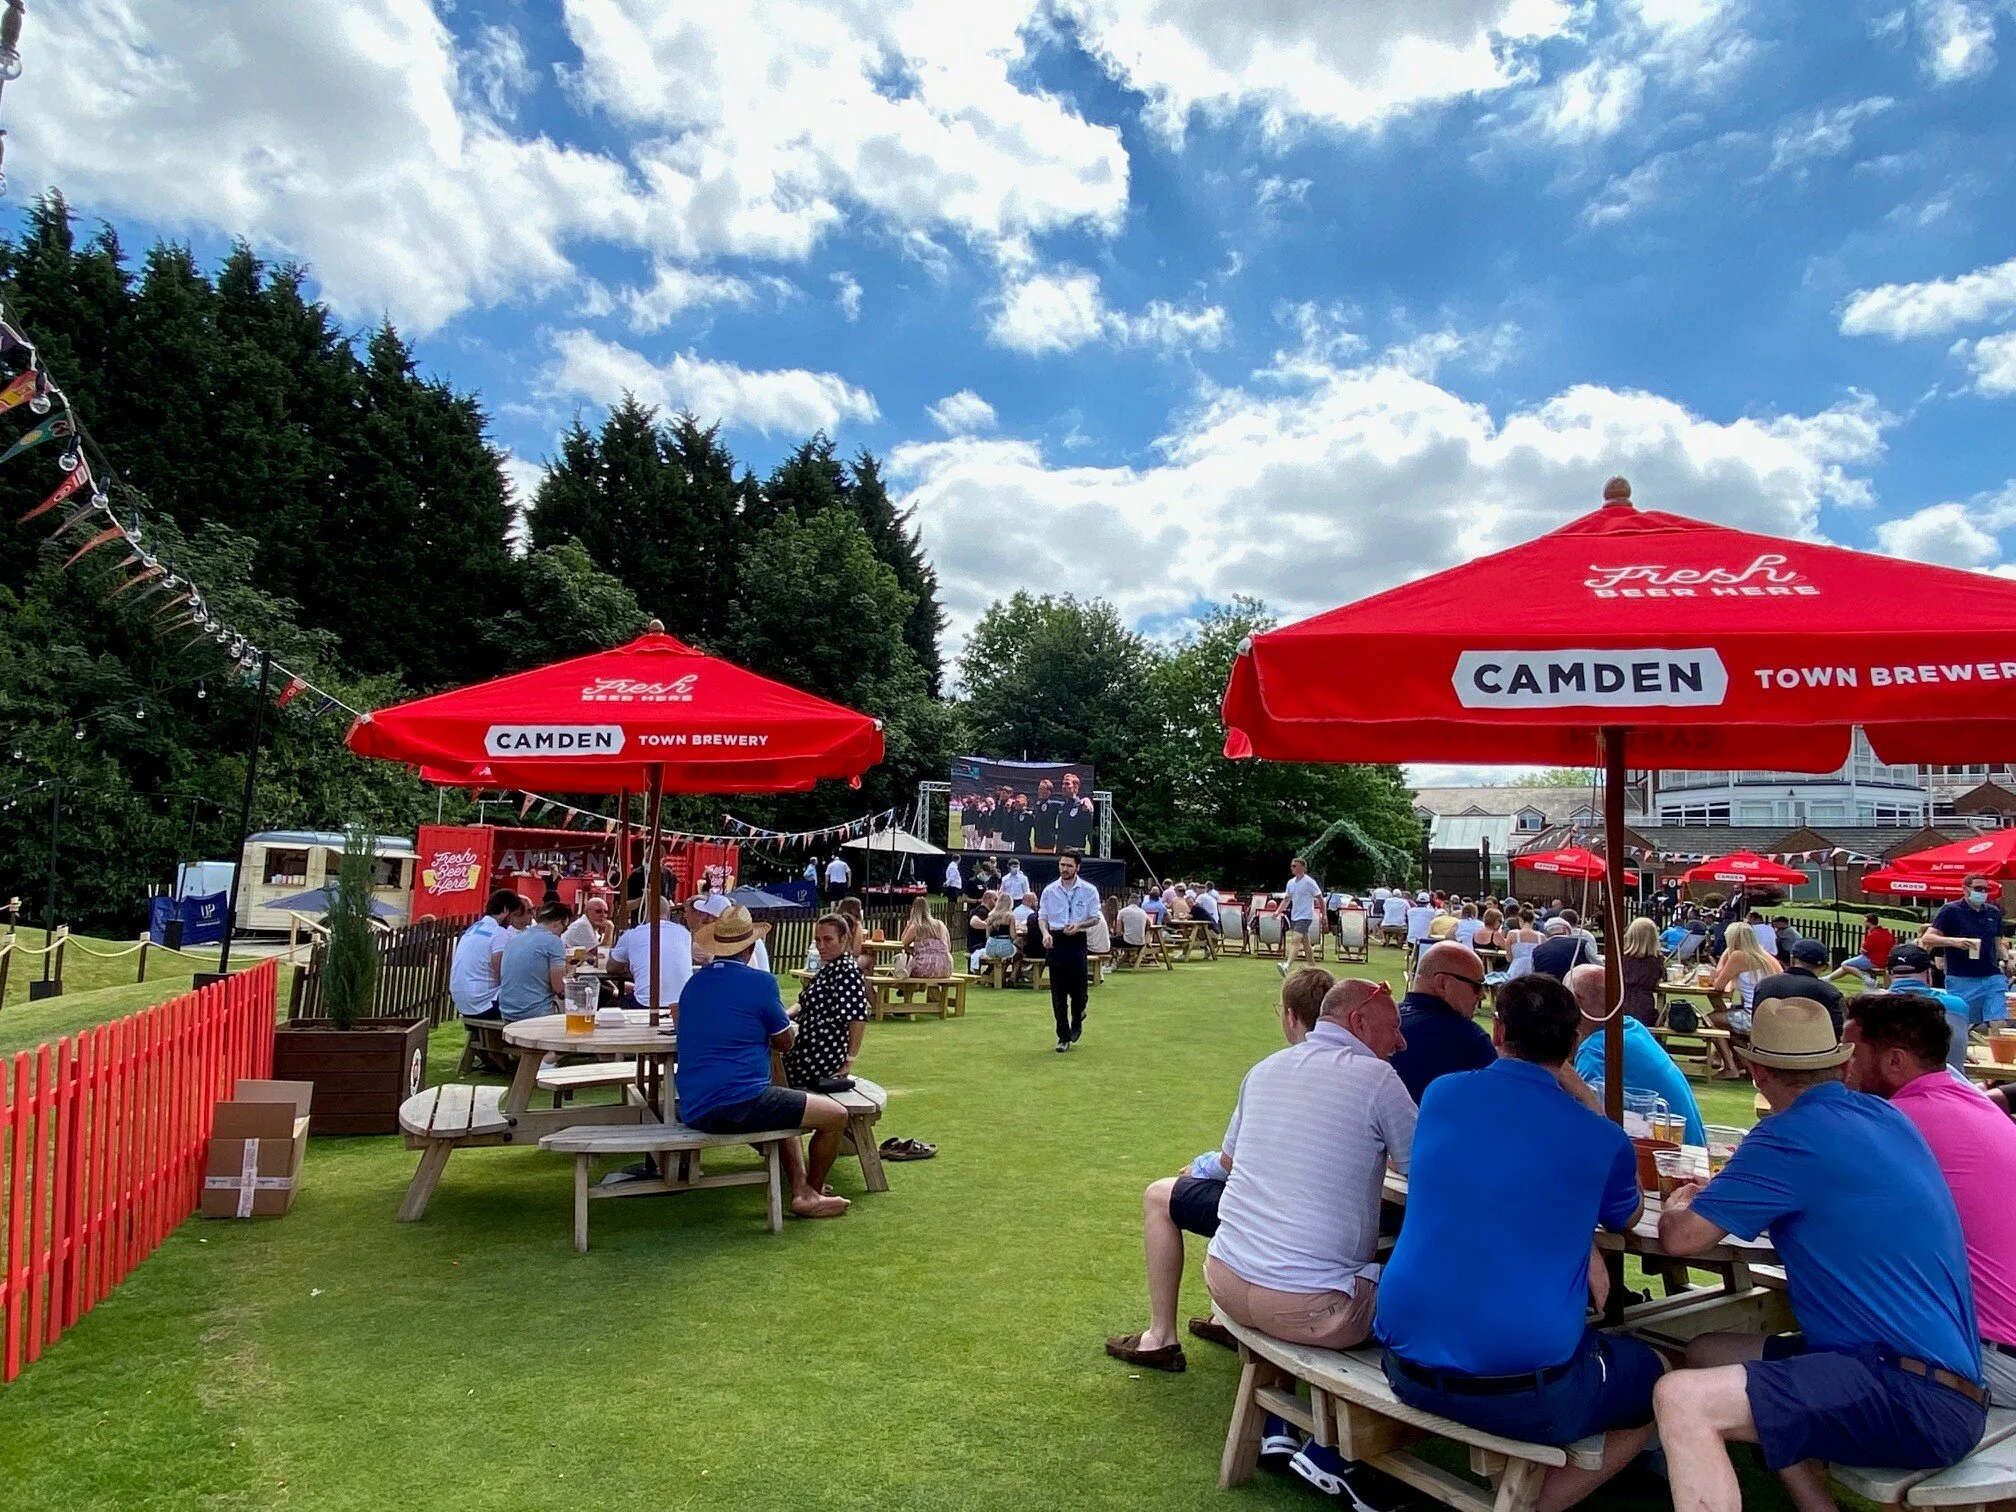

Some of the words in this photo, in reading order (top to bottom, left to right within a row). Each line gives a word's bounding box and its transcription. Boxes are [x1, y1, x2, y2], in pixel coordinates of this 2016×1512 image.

[1583, 554, 1798, 588] Fresh
[1594, 588, 1698, 598] BEER
[1710, 585, 1821, 596] HERE
[581, 674, 699, 694] Fresh
[1473, 662, 1703, 695] CAMDEN
[1754, 666, 1858, 689] TOWN
[581, 694, 633, 702] BEER
[641, 694, 693, 702] HERE
[496, 732, 612, 750] CAMDEN
[639, 735, 686, 746] TOWN
[692, 734, 769, 746] BREWERY
[431, 847, 477, 867] Fresh
[435, 863, 469, 880] Beer
[428, 877, 472, 896] Here
